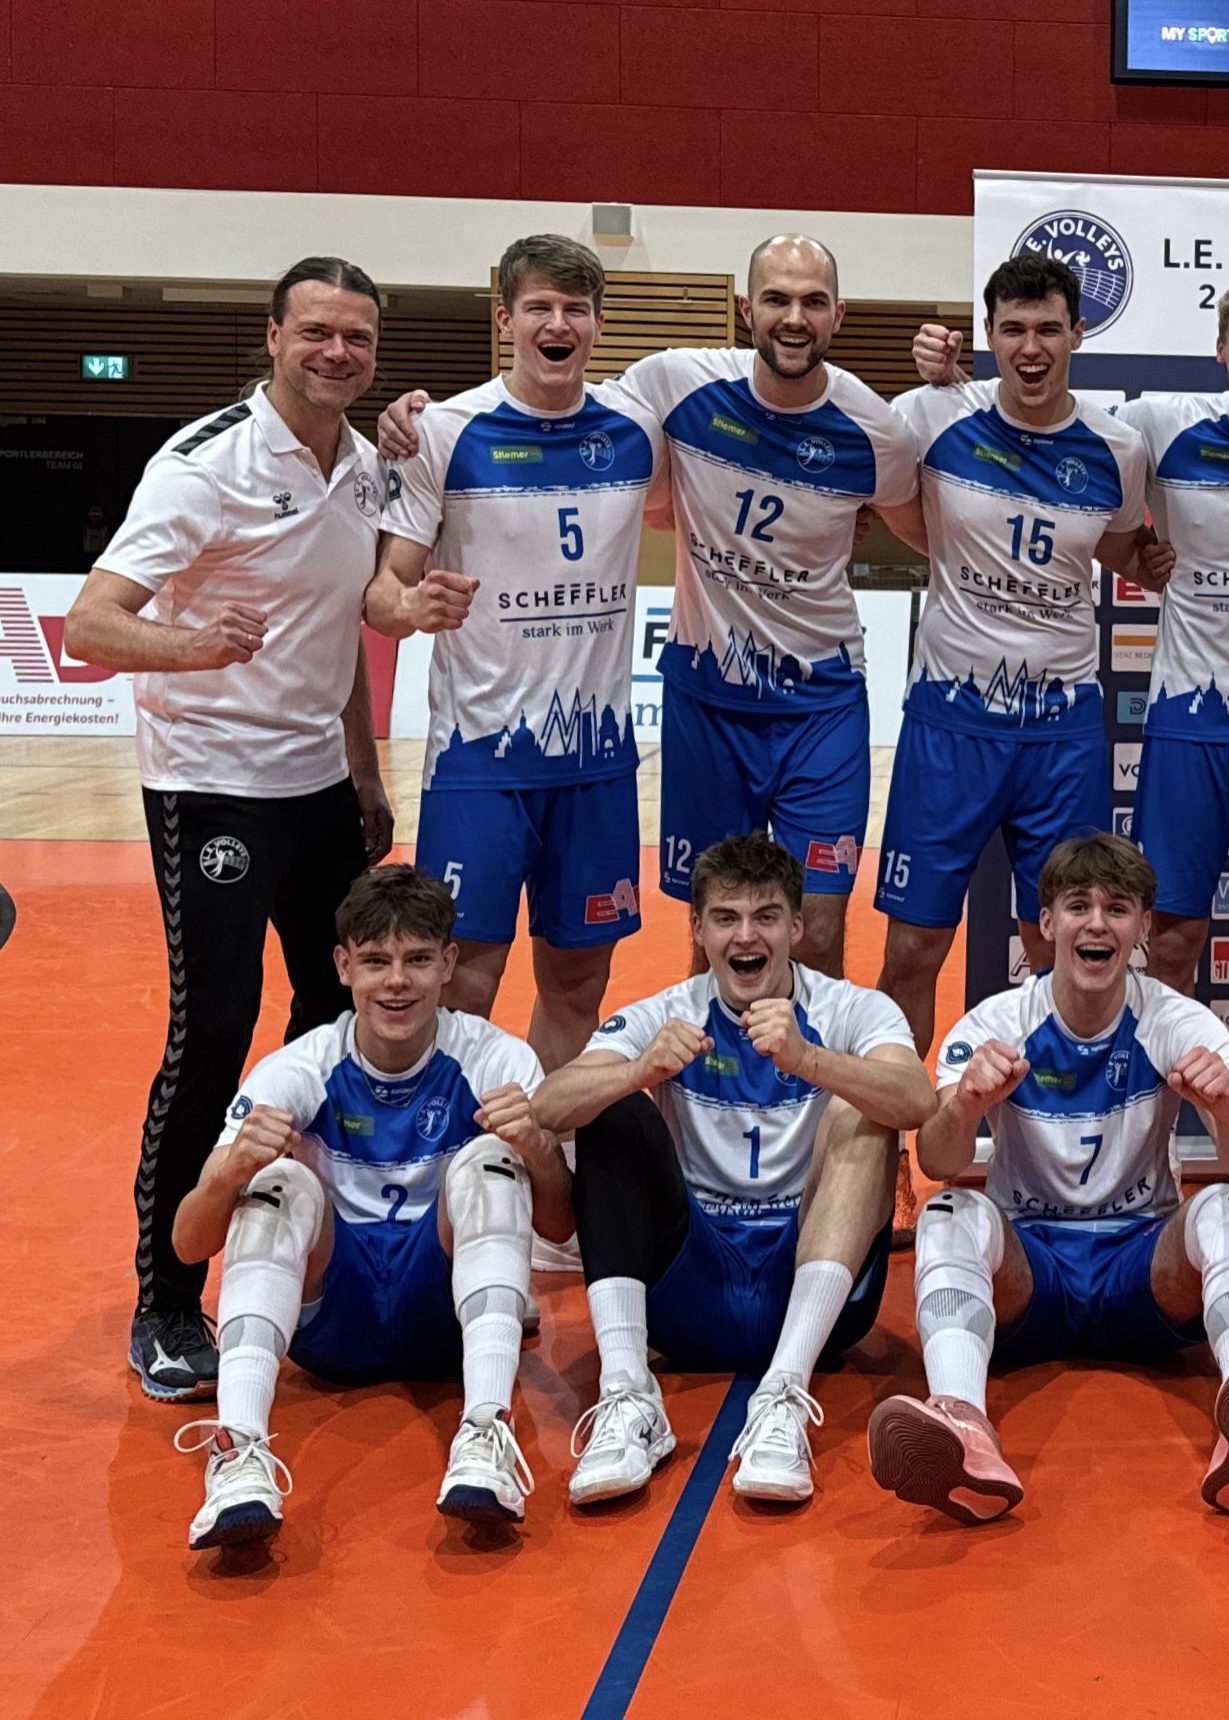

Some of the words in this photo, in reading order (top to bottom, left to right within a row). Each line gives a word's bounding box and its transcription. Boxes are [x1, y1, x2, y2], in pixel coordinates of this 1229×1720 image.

[1162, 27, 1184, 41] MY
[1045, 218, 1125, 271] VOLLEYS
[1163, 238, 1223, 269] L.E.
[558, 507, 584, 561] 5
[735, 488, 785, 543] 12
[1006, 514, 1056, 566] 15
[498, 582, 627, 609] SCHEFFLER
[960, 566, 1081, 601] SCHEFFLER
[522, 623, 562, 638] stark
[566, 623, 583, 636] im
[587, 619, 614, 635] Werk
[0, 694, 103, 707] uchsabrechnung
[26, 712, 119, 726] Energiekosten!
[666, 835, 692, 874] 12
[884, 850, 912, 888] 15
[443, 861, 464, 899] 5
[743, 1126, 760, 1178] 1
[1080, 1134, 1103, 1186] 7
[381, 1184, 412, 1225] 2
